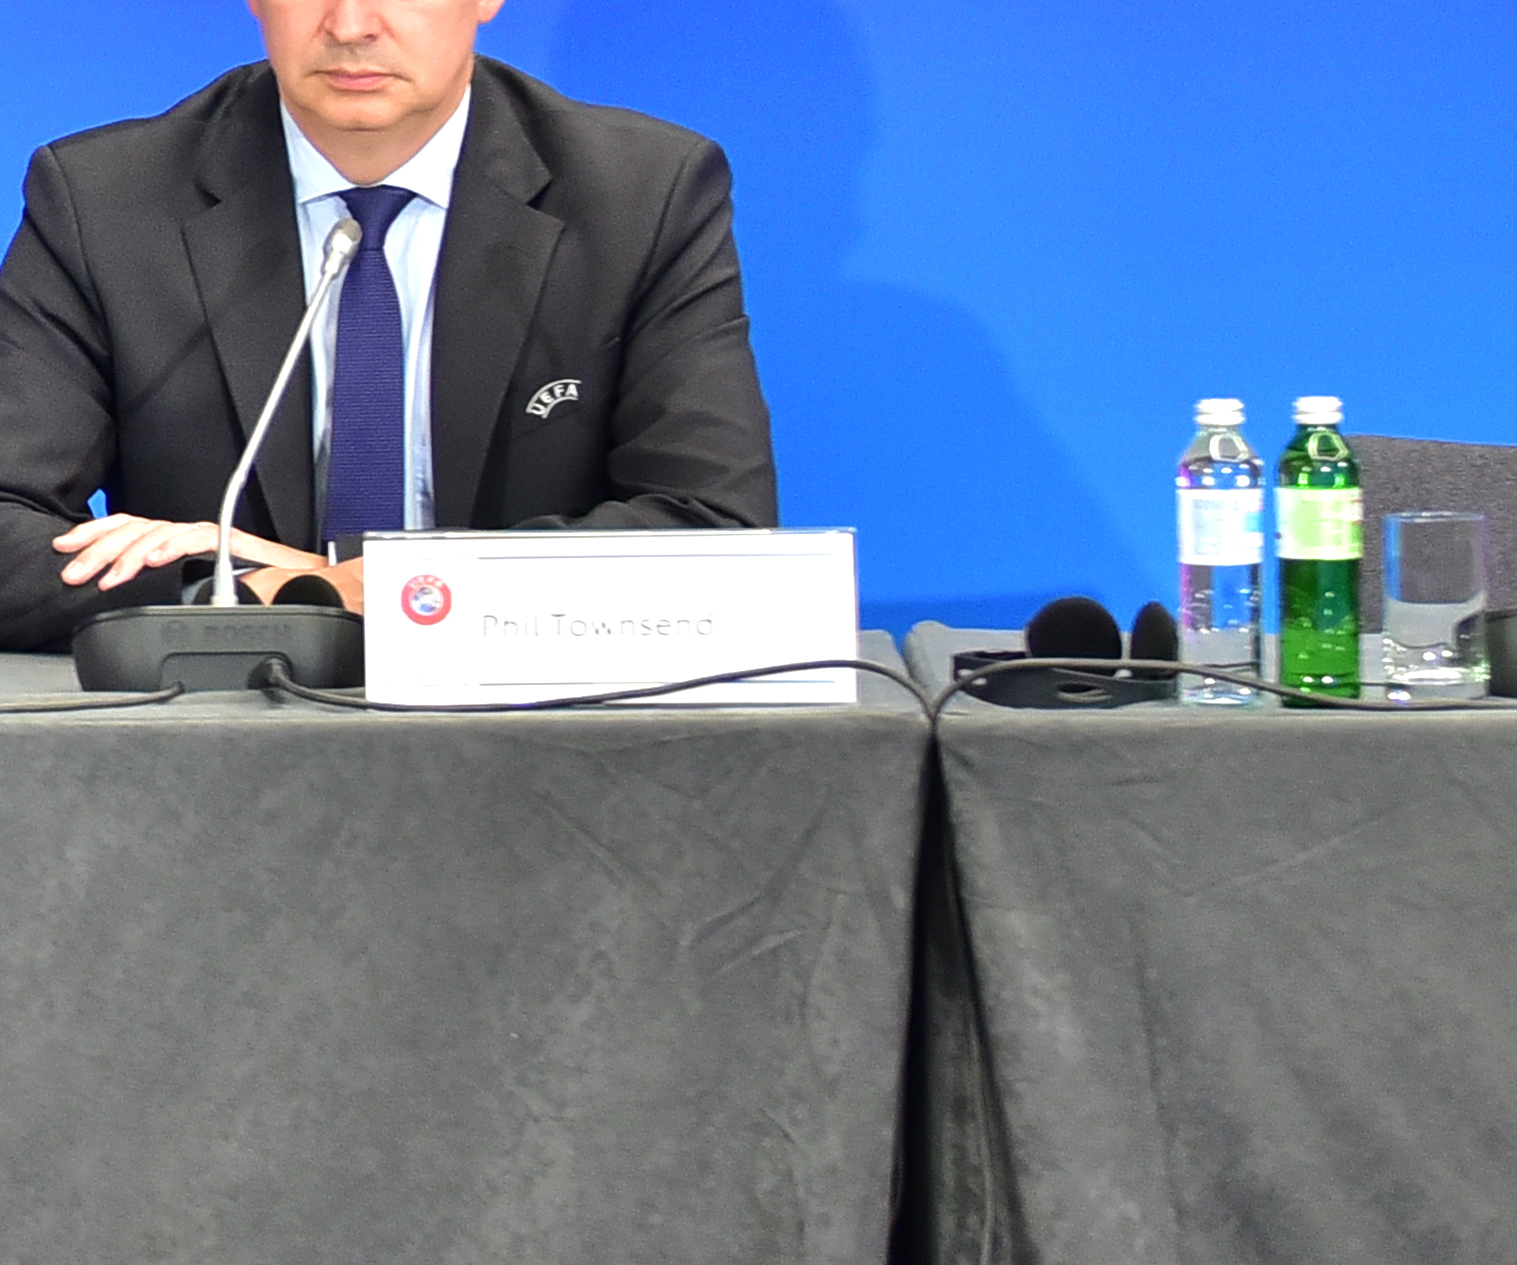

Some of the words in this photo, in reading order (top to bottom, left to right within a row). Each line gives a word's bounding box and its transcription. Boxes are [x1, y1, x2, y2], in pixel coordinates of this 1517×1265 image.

[531, 383, 579, 416] UEFA
[482, 614, 540, 637] Phil
[550, 613, 714, 637] Townsend
